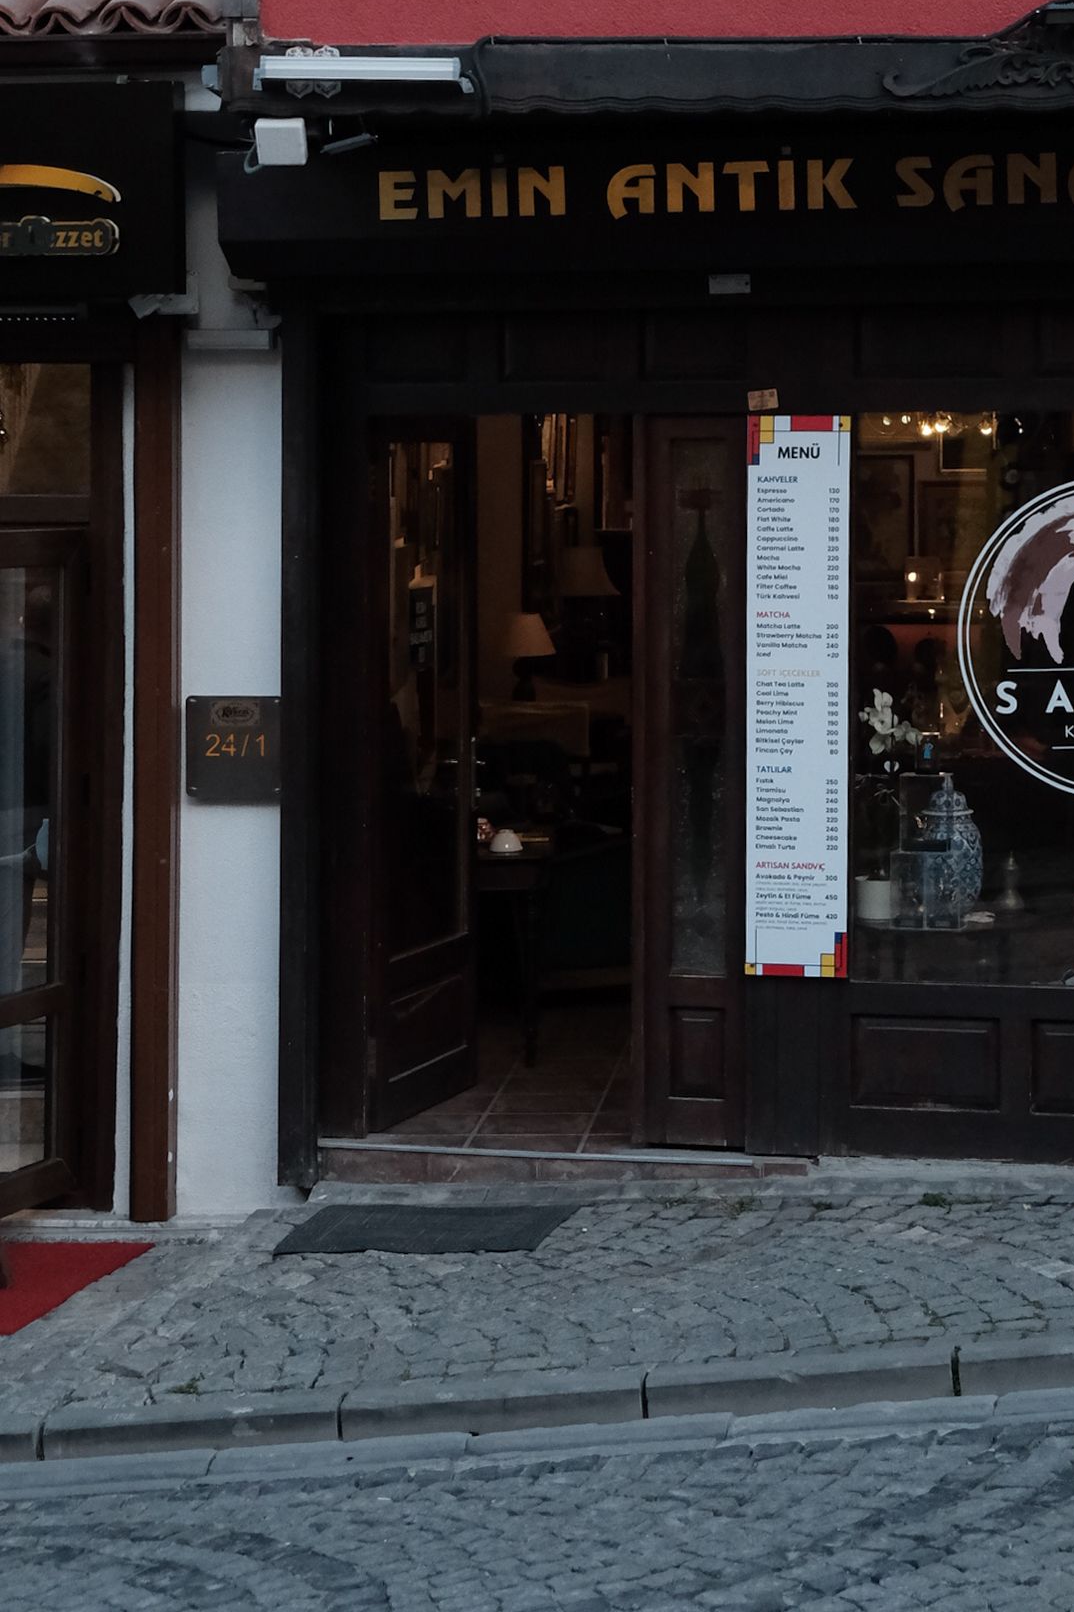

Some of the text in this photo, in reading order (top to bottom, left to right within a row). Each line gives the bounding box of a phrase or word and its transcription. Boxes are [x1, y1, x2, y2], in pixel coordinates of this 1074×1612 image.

[379, 153, 567, 220] EMİN
[607, 146, 858, 220] ANTİK
[777, 442, 821, 460] MENÜ
